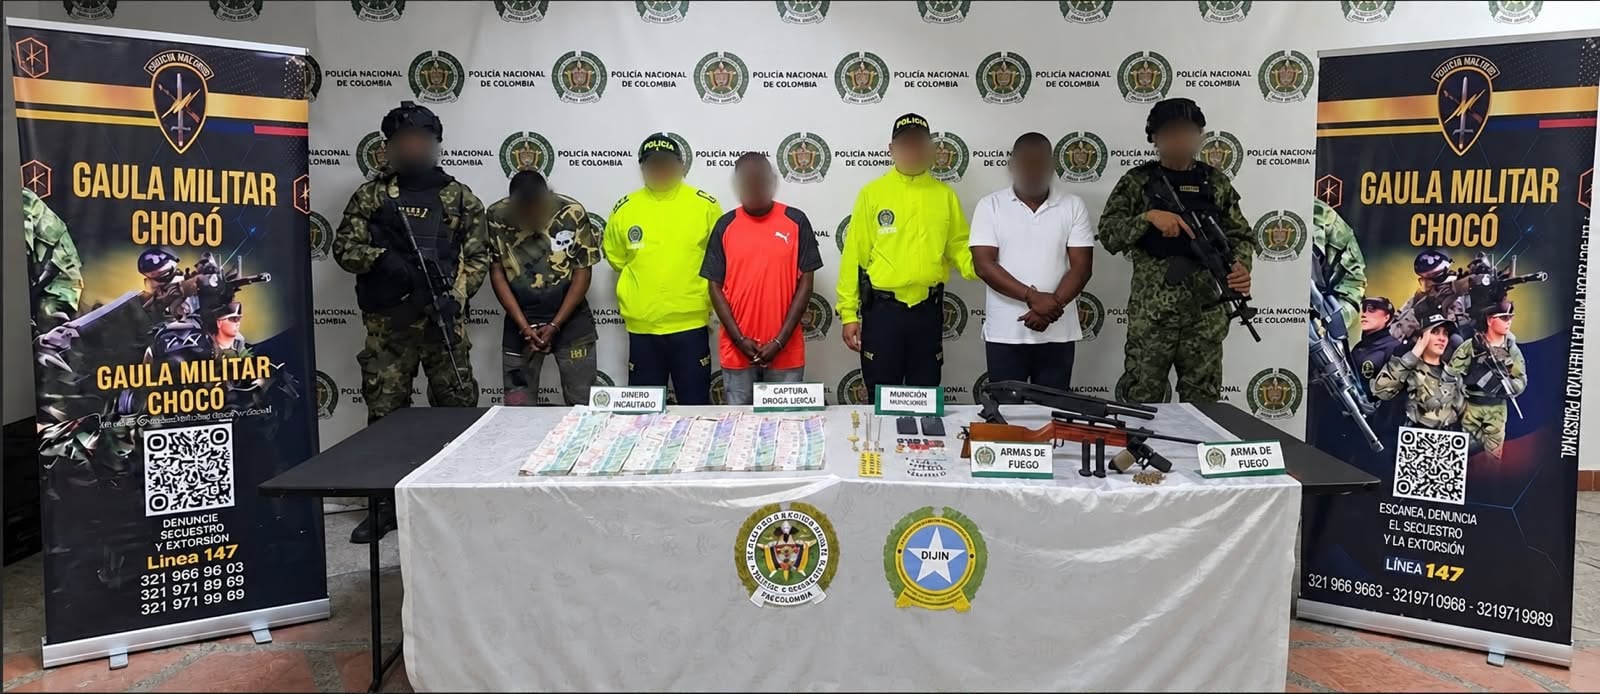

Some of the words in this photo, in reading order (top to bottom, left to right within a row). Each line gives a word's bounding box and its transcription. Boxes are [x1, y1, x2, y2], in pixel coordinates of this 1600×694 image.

[360, 70, 402, 78] NACIONAL
[503, 70, 546, 78] NACIONAL
[622, 80, 632, 88] DE
[635, 80, 676, 88] COLOMBIA
[591, 150, 632, 158] NACIONAL
[72, 162, 165, 201] GAULA
[174, 166, 277, 206] MILITAR
[1360, 170, 1443, 205] GAULA
[1450, 168, 1560, 204] MILITAR
[132, 208, 222, 247] CHOCÓ
[1410, 206, 1498, 248] CHOCÓ
[97, 362, 173, 390] GAULA
[148, 383, 225, 415] CHOCÓ
[1000, 448, 1032, 456] ARMAS
[1034, 449, 1046, 457] DE
[1231, 447, 1258, 456] ARMA
[1260, 446, 1272, 455] DE
[1008, 460, 1039, 469] FUEGO
[1239, 458, 1269, 468] FUEGO
[163, 514, 218, 528] DENUNCIE
[1428, 508, 1477, 525] DENUNCIA
[160, 524, 224, 540] SECUESTRO
[1389, 520, 1400, 530] EL
[1404, 521, 1462, 539] SECUESTRO
[155, 542, 163, 552] Y
[1384, 534, 1391, 544] Y
[1392, 536, 1405, 547] LA
[1408, 538, 1465, 555] EXTORSIÓN
[147, 552, 199, 570] Linea
[204, 544, 239, 561] 147
[921, 550, 950, 561] DIJIN
[140, 572, 166, 586] 321
[172, 568, 199, 581] 966
[204, 565, 222, 577] 96
[226, 562, 244, 573] 03
[1386, 557, 1422, 575] LÍNEA
[1426, 563, 1465, 582] 147
[141, 587, 166, 600] 321
[172, 582, 198, 596] 971
[204, 579, 222, 591] 89
[226, 575, 244, 587] 69
[141, 601, 166, 615] 321
[172, 596, 198, 610] 971
[204, 593, 222, 605] 99
[226, 589, 244, 601] 69
[1308, 574, 1327, 589] 321
[1331, 577, 1352, 592] 966
[1355, 581, 1382, 598] 9663
[1392, 588, 1466, 612] 3219710968
[1477, 601, 1553, 627] 3219719989
